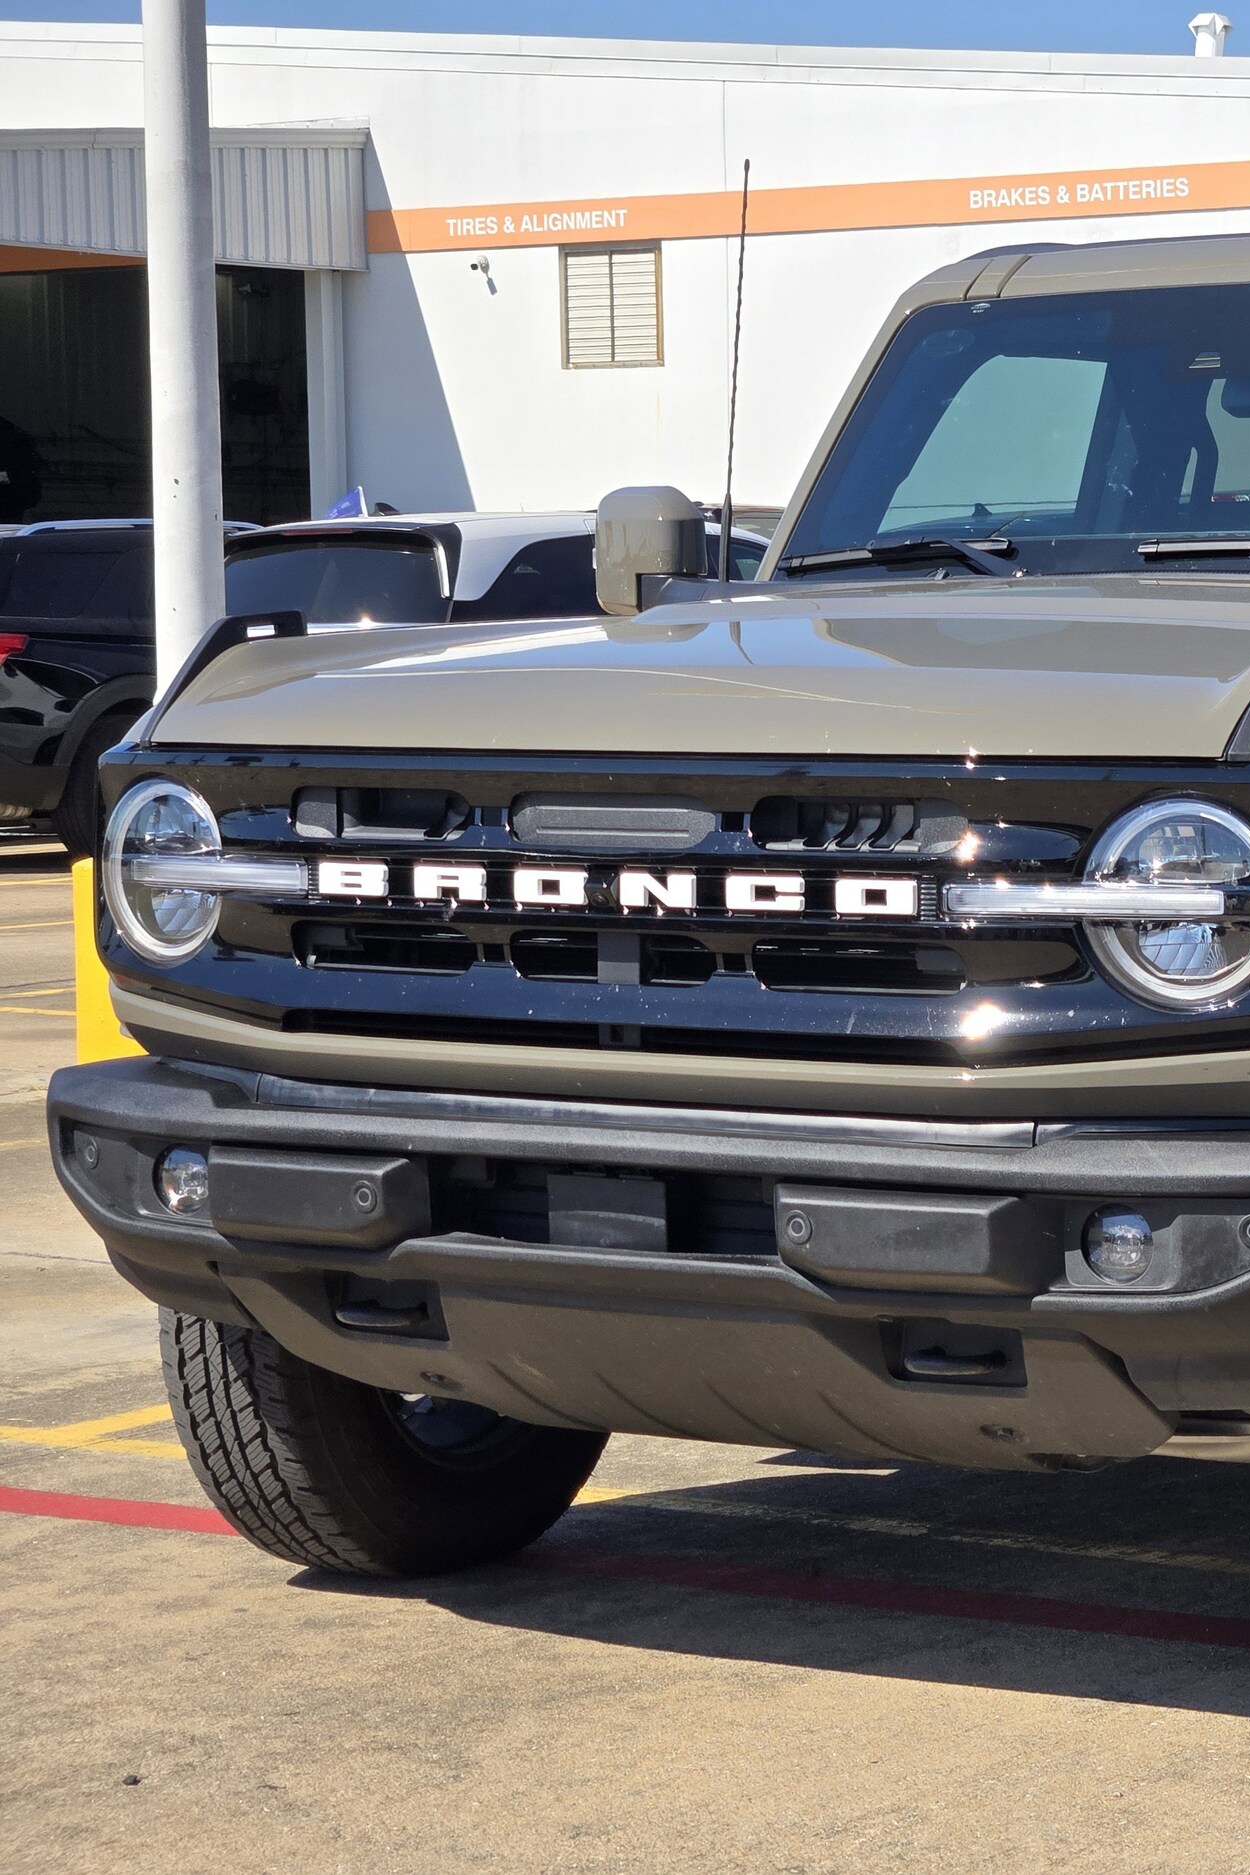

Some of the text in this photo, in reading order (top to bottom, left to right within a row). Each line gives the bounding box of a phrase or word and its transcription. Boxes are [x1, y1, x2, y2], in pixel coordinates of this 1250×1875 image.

[969, 177, 1189, 209] BRAKES & BATTERIES
[446, 209, 627, 237] TIRES & ALIGNMENT
[318, 861, 918, 917] BRONCO
